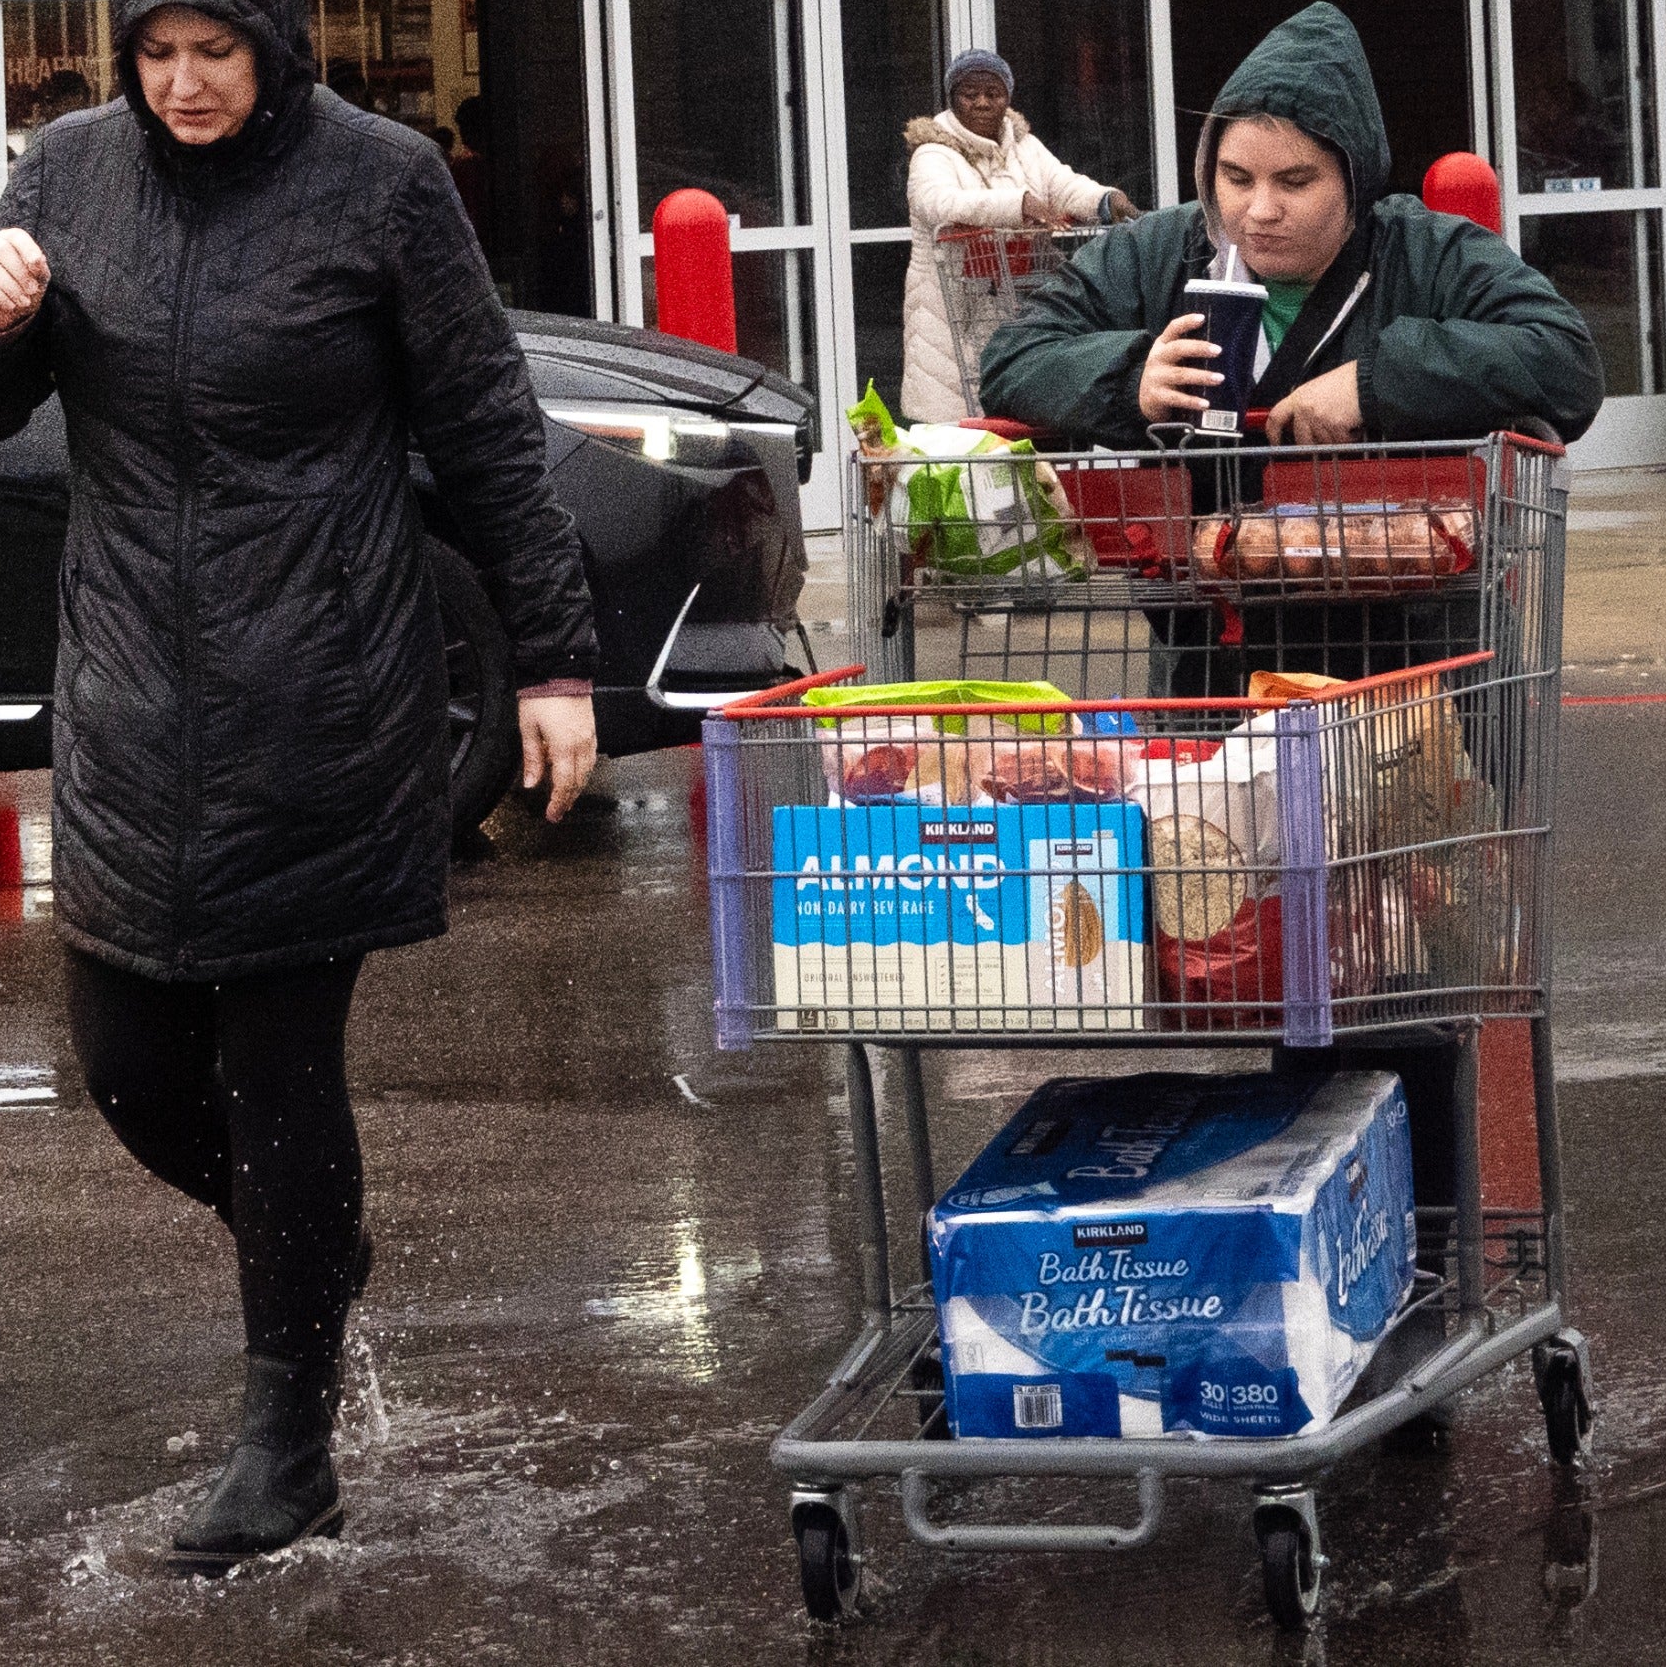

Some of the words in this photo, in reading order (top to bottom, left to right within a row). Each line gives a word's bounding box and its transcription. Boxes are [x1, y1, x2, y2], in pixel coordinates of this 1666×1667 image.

[797, 854, 1006, 891] ALMOND
[797, 900, 866, 915] NON-DARY
[873, 900, 935, 915] BEVRAGE
[803, 972, 843, 983] ORIGNAL
[849, 972, 905, 983] NSWETENED
[1076, 1224, 1145, 1238] KIRKLAND
[1039, 1251, 1110, 1285] Bath
[1109, 1249, 1190, 1282] Tissue
[1021, 1288, 1117, 1334] Bath
[1116, 1285, 1224, 1326] Tissue
[1200, 1380, 1225, 1402] 30
[1231, 1384, 1279, 1404] 380
[1199, 1411, 1229, 1423] WIDE
[1233, 1415, 1281, 1424] SHEETS
